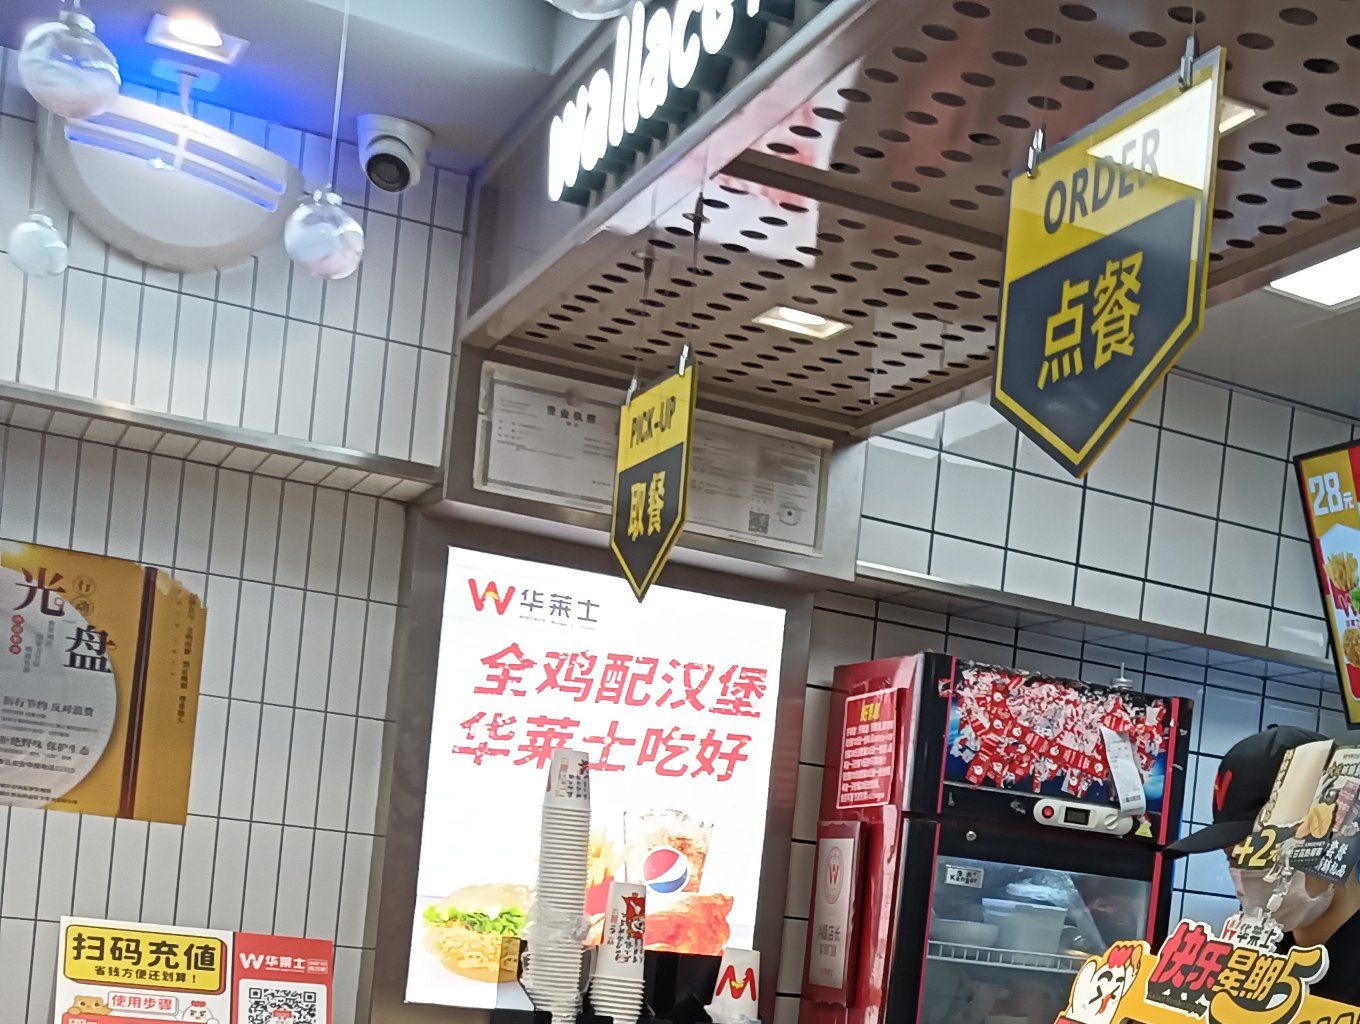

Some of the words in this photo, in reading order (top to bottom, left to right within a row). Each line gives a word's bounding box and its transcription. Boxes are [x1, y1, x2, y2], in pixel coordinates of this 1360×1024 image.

[1044, 128, 1161, 235] ORDER
[1037, 251, 1144, 390] 点餐
[629, 395, 677, 449] PICK-UP
[628, 470, 667, 541] 取餐
[1307, 472, 1355, 516] 28元
[13, 566, 67, 617] 光
[62, 625, 118, 674] 盘
[519, 588, 601, 624] 华莱士
[472, 642, 768, 718] 全鸡配汉堡
[451, 711, 753, 783] 华莱士吃好
[94, 964, 198, 984] 省钱方便还划算！
[264, 954, 306, 971] 华莱士
[110, 993, 173, 1012] 使用步骤
